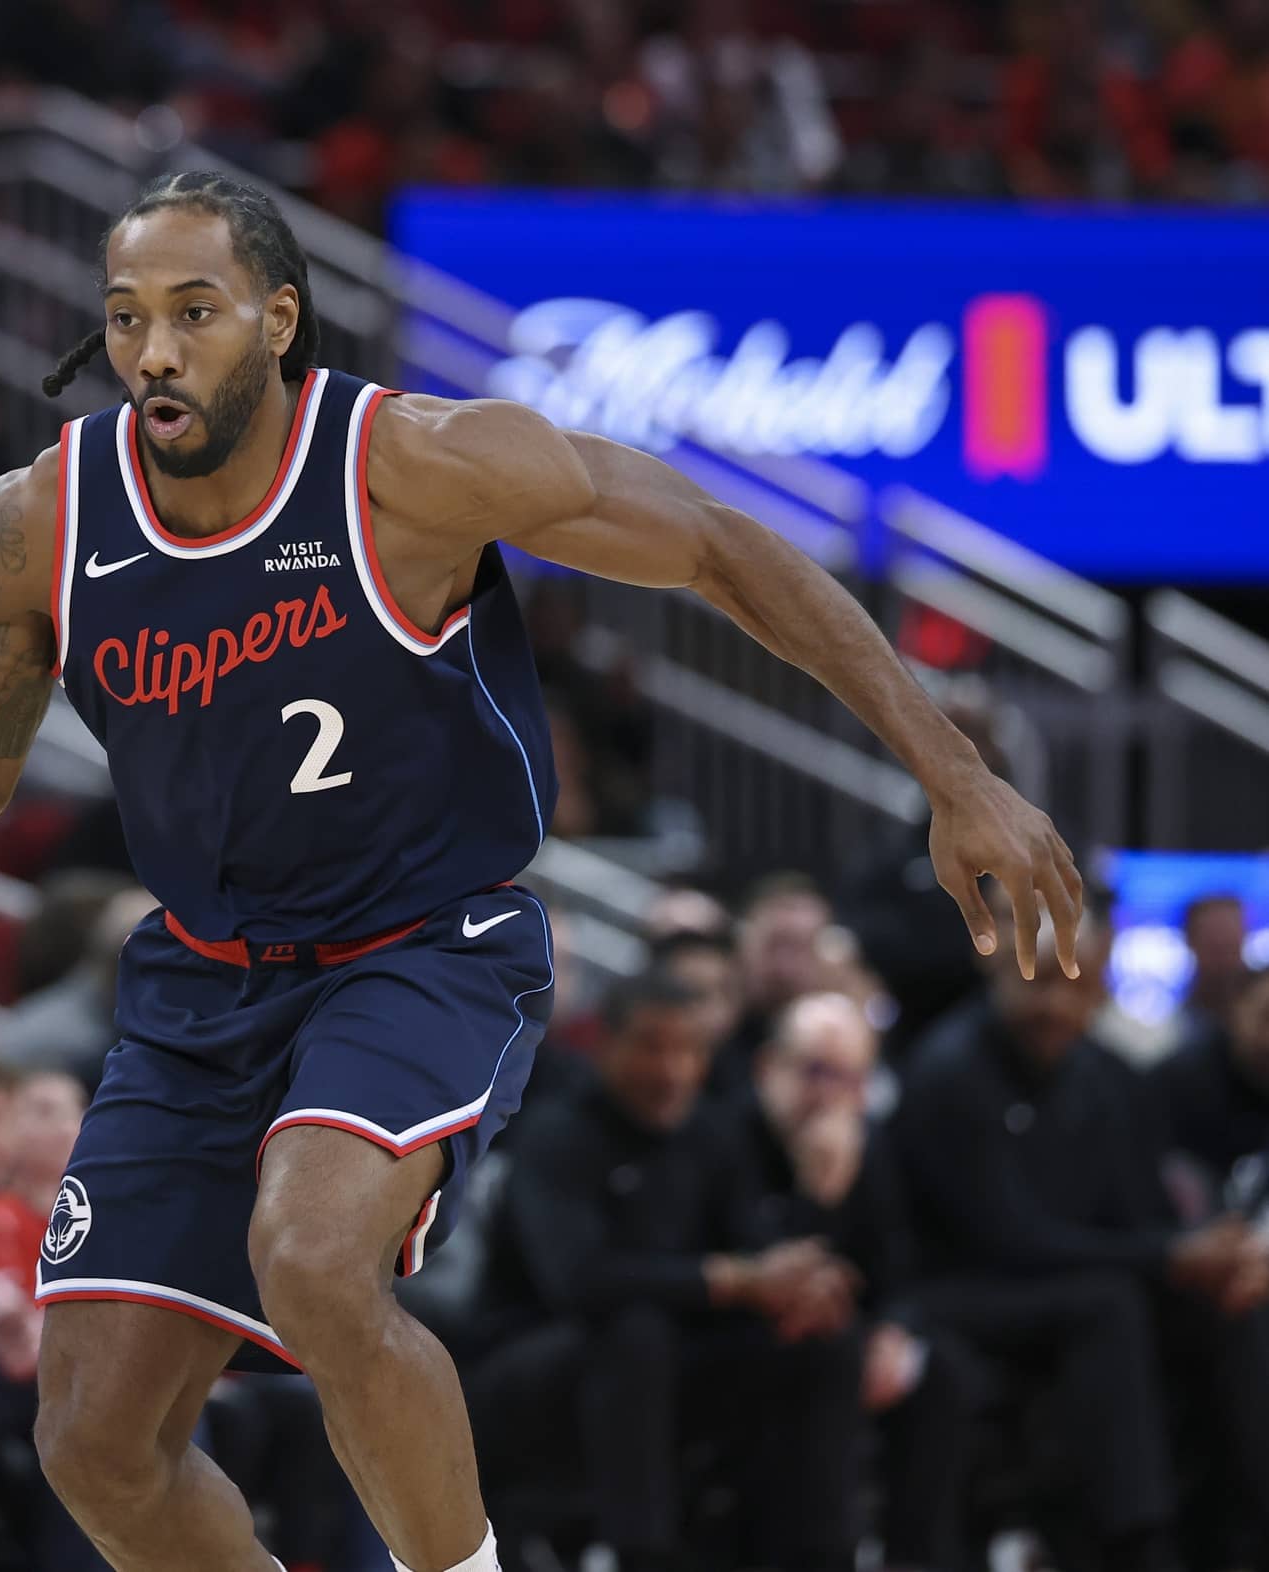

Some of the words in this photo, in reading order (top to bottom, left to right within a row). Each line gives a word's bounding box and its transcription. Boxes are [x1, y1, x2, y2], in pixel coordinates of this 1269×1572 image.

[264, 554, 341, 573] RWANDA
[279, 541, 323, 557] VISIT
[93, 584, 347, 716] Clippers
[281, 699, 353, 794] 2
